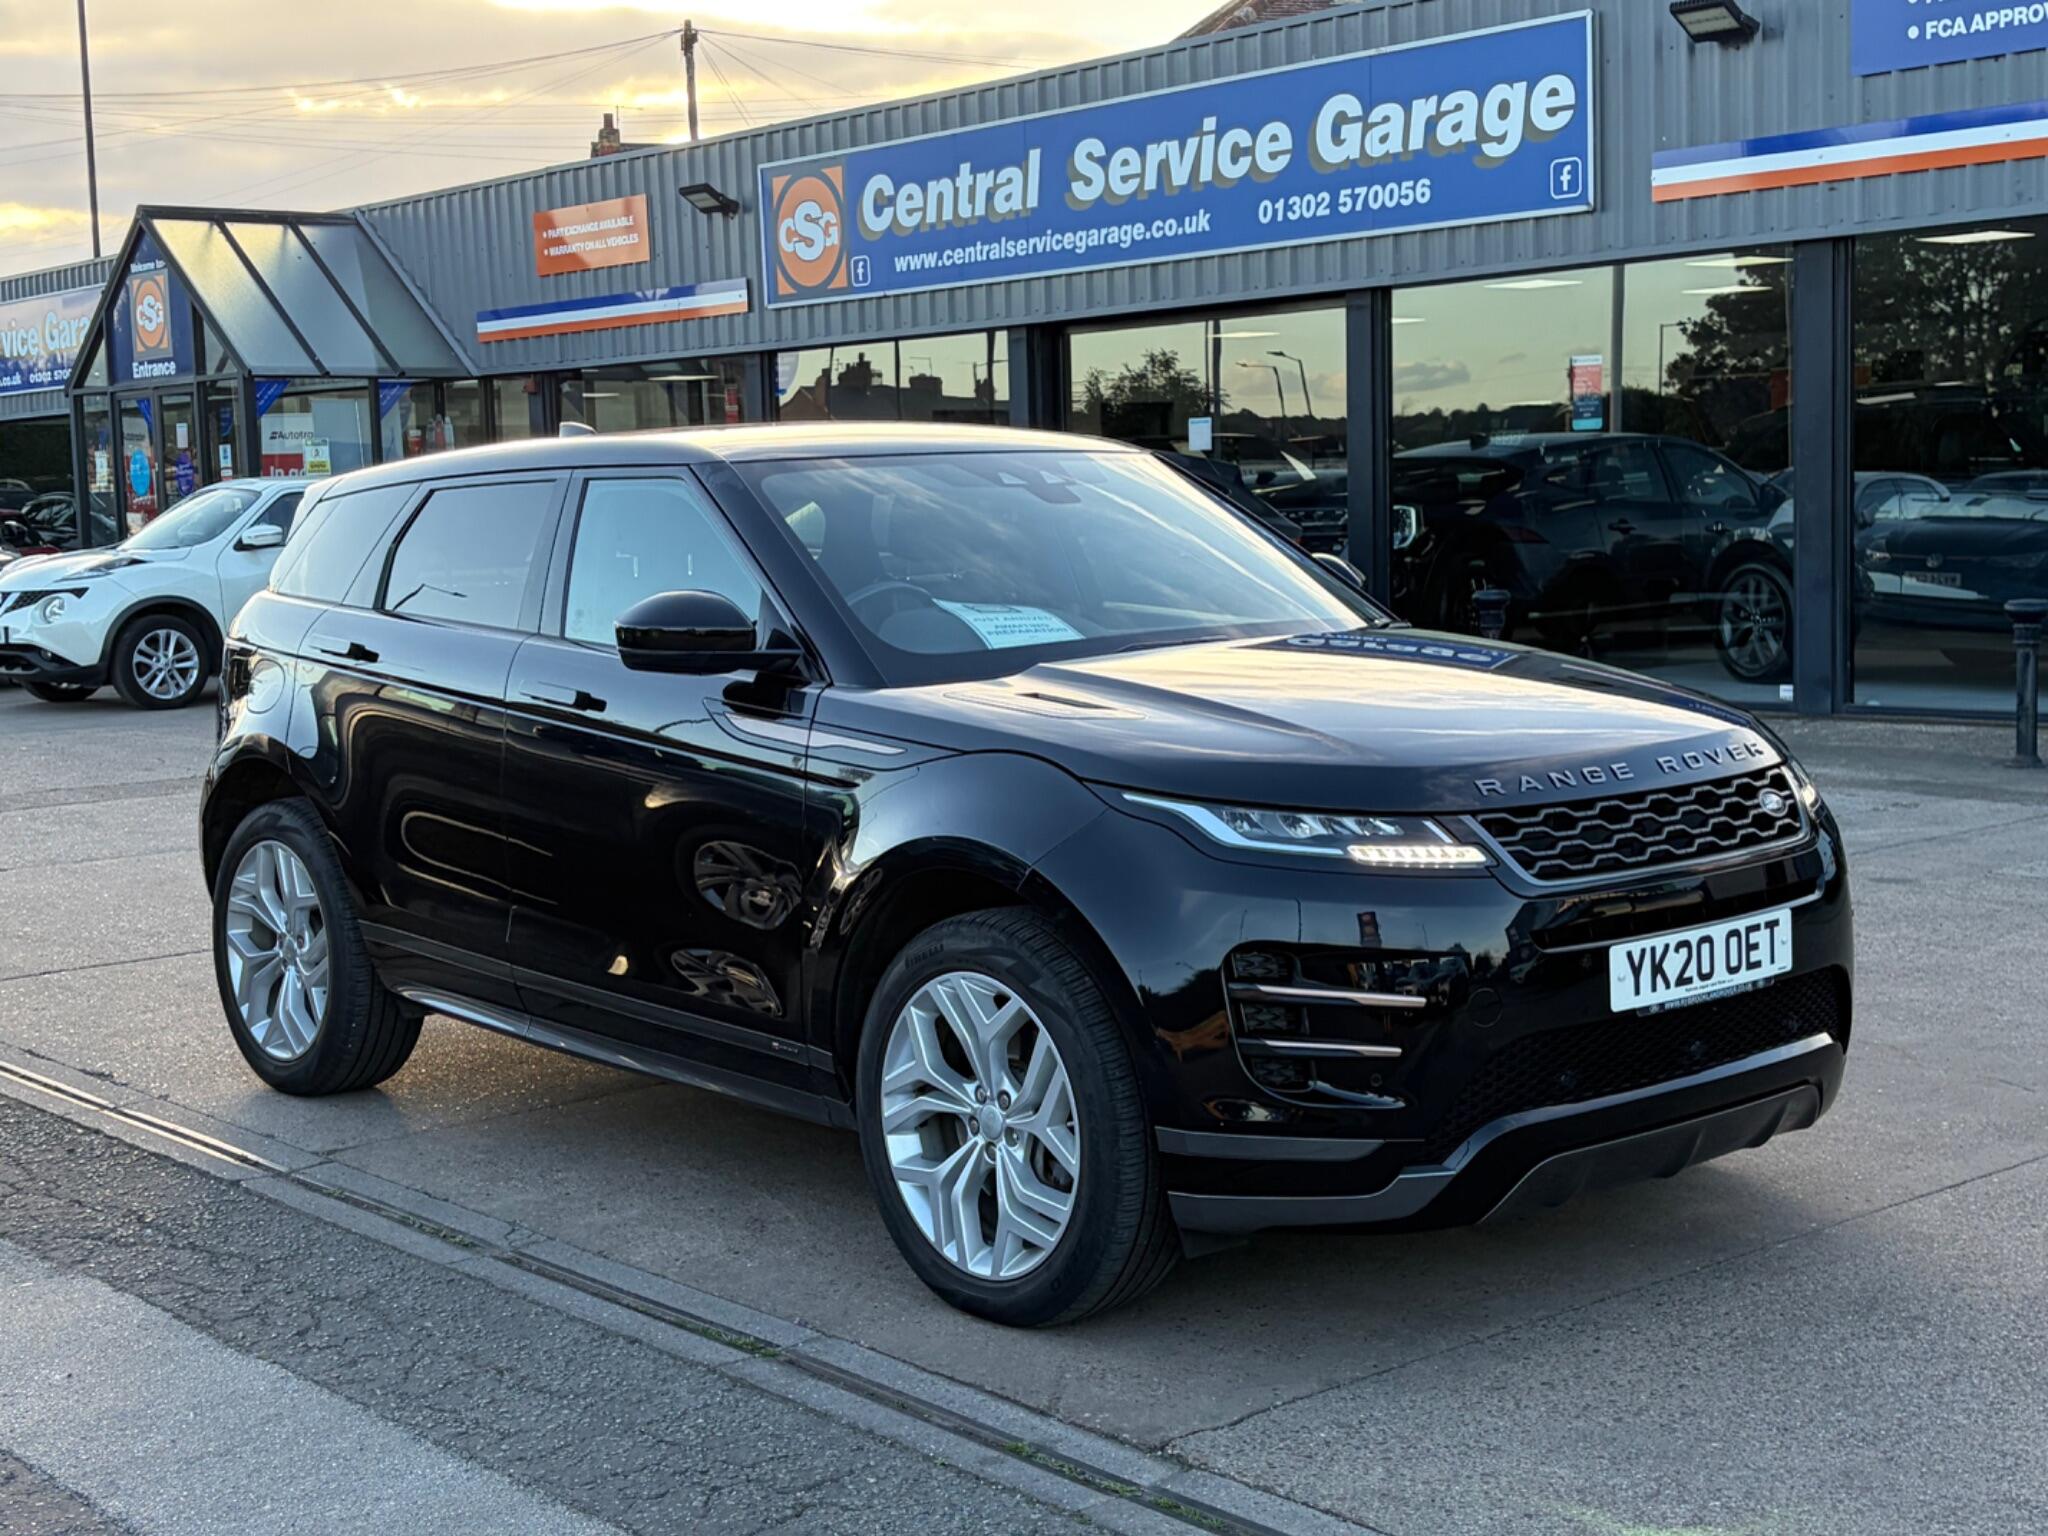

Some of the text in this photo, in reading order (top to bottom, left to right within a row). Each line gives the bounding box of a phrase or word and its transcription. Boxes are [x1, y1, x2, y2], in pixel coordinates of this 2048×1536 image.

[1925, 17, 1967, 40] FCA
[862, 73, 1576, 233] Central Service Garage
[1258, 178, 1431, 224] 01302 570056
[779, 201, 839, 261] CSG
[895, 209, 1211, 272] www.centralservicegarage.co.uk
[136, 294, 164, 332] CSG
[131, 360, 177, 379] Entrance
[1473, 742, 1765, 797] RANGE ROVER
[1626, 934, 1715, 997] YK20
[1725, 917, 1780, 975] OET
